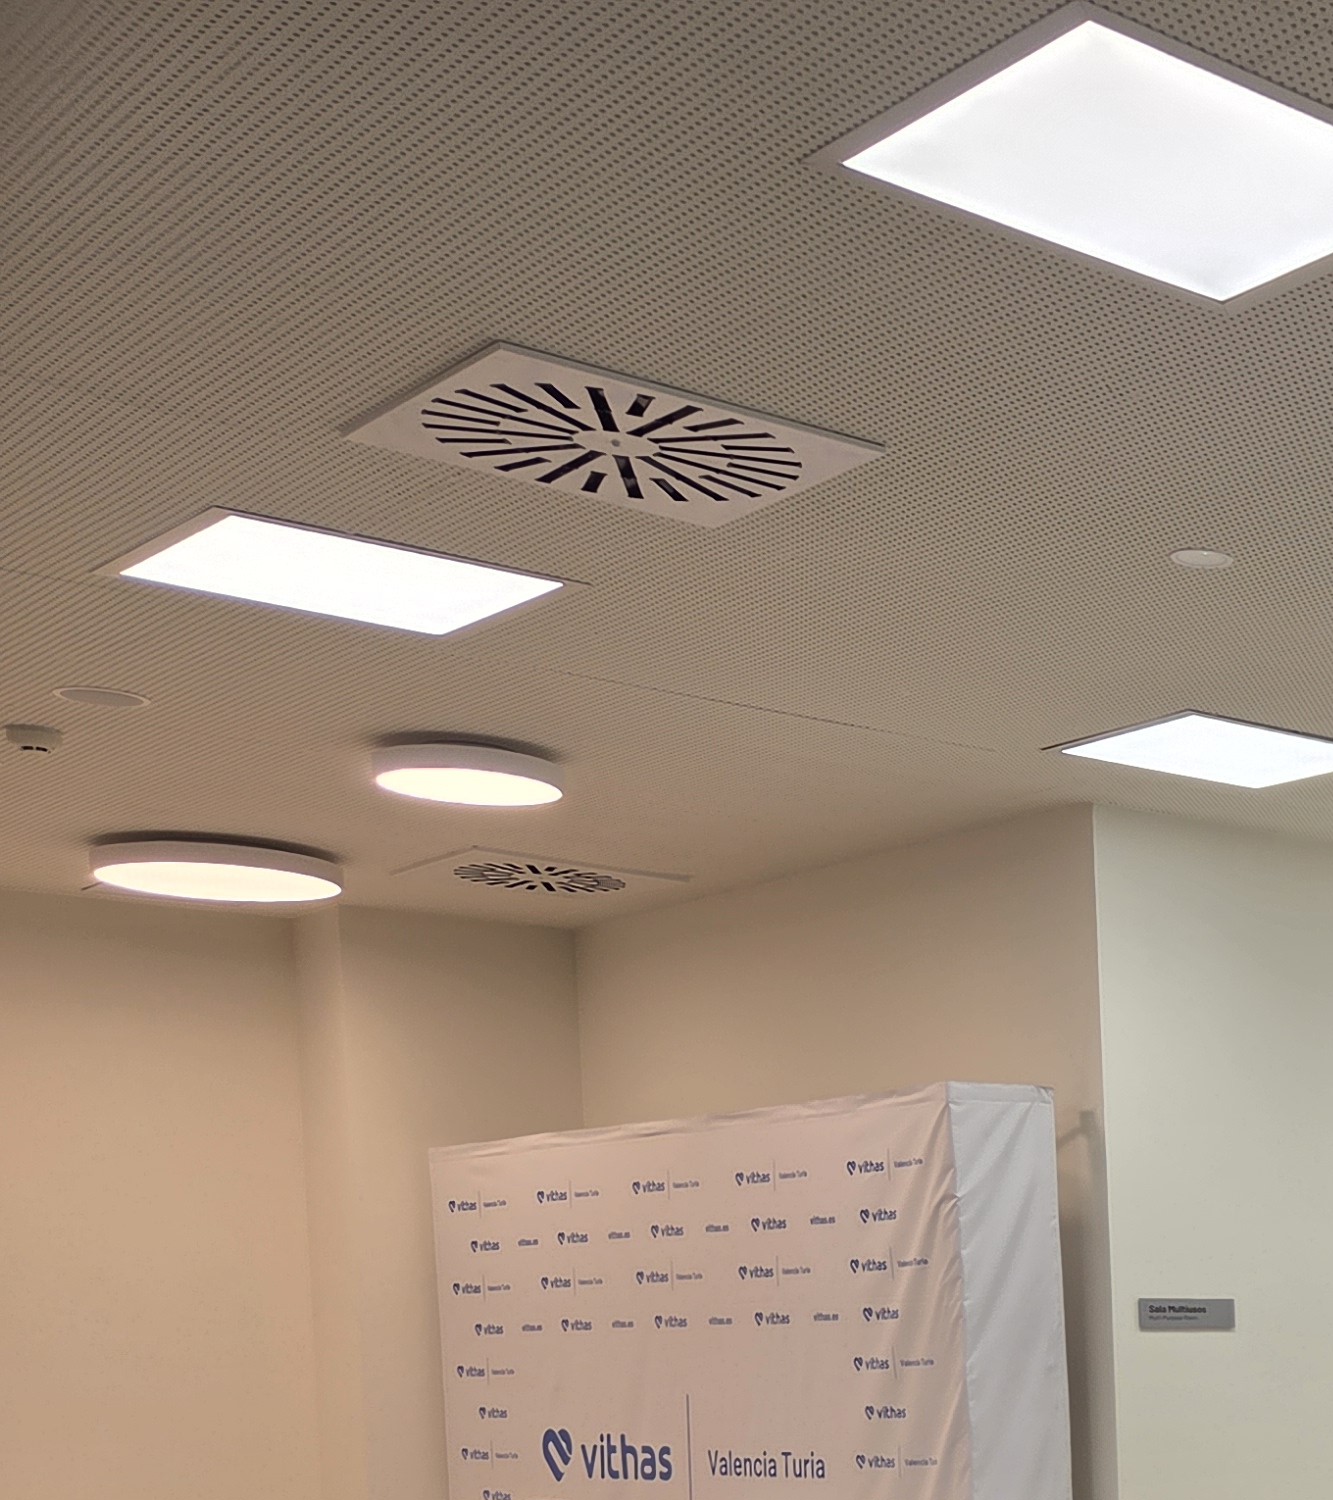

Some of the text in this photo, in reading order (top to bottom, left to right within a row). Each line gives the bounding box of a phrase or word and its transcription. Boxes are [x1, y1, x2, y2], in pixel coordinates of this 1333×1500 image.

[876, 1406, 906, 1419] vithas
[580, 1433, 826, 1481] vithas Valencia Turia
